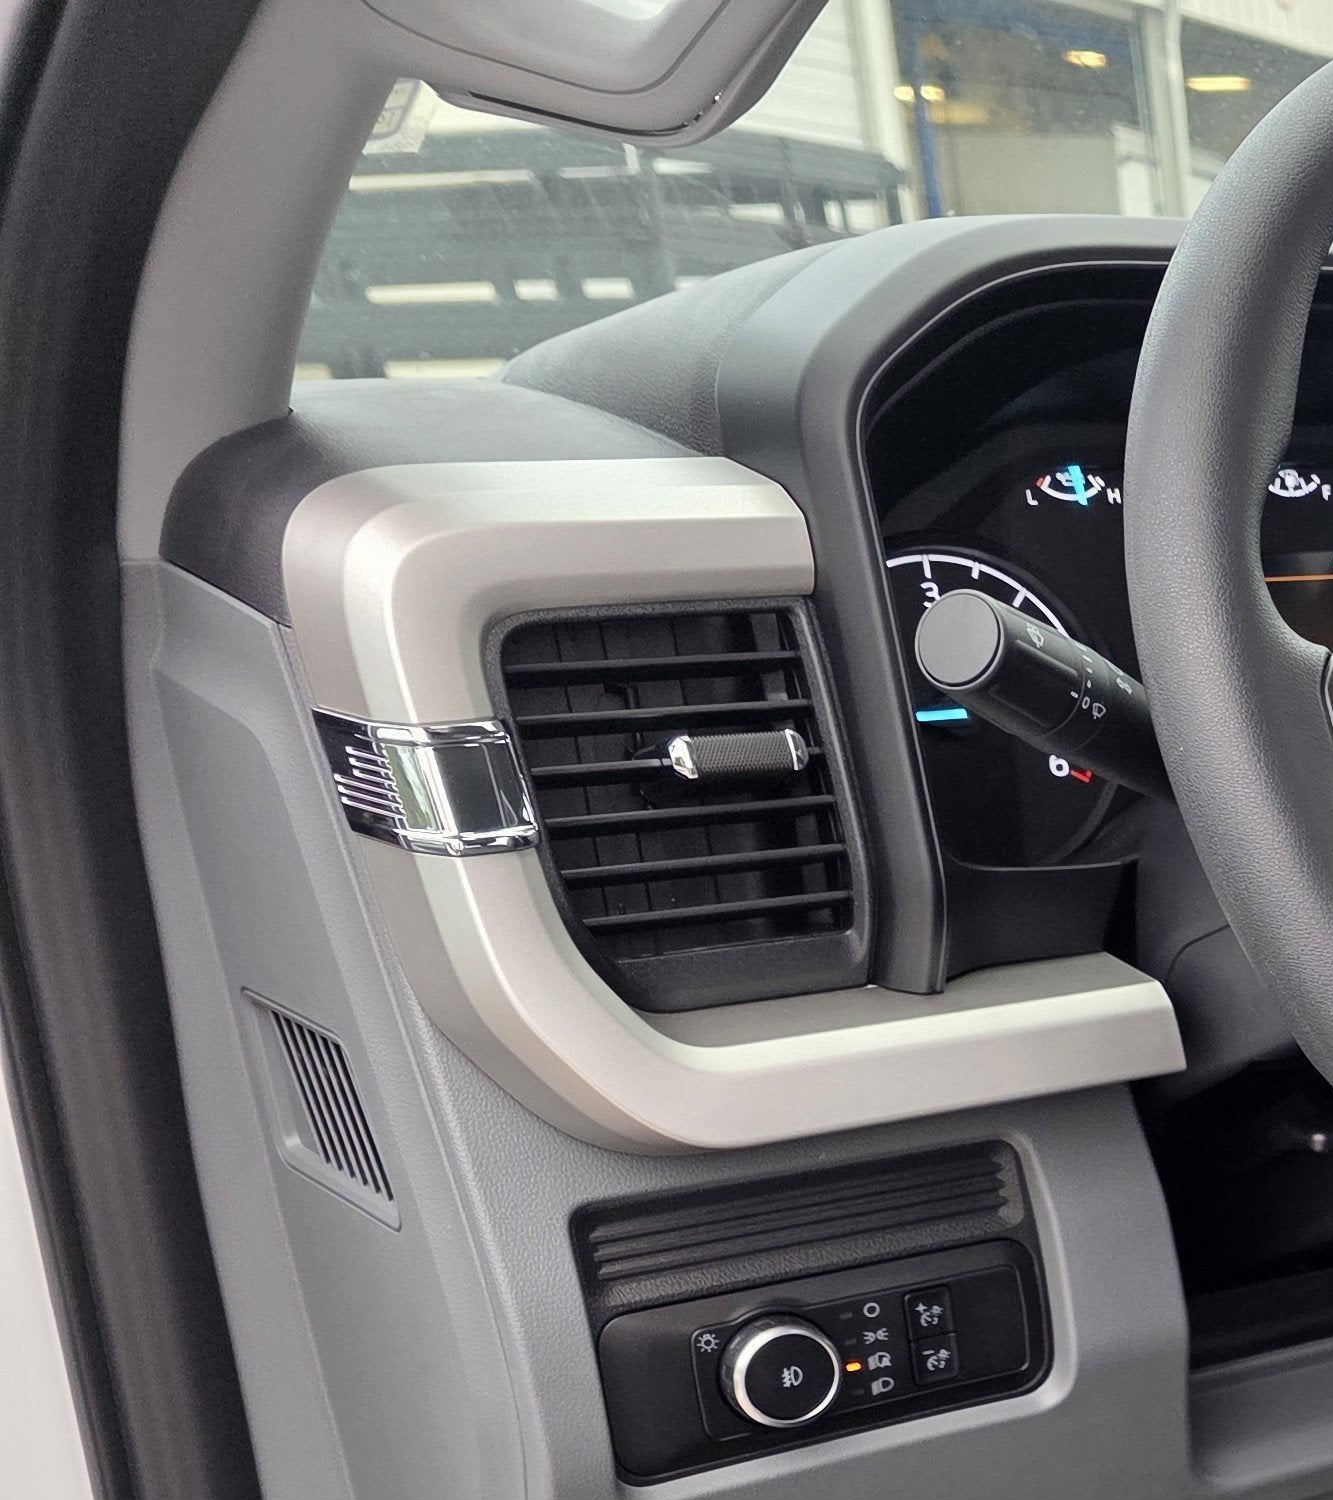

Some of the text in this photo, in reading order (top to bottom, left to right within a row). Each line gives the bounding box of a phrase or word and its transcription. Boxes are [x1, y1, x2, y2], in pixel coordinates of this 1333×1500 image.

[1025, 489, 1038, 506] L
[1106, 487, 1122, 505] H
[1321, 484, 1331, 500] F
[920, 581, 941, 608] 3
[1049, 754, 1070, 777] 6
